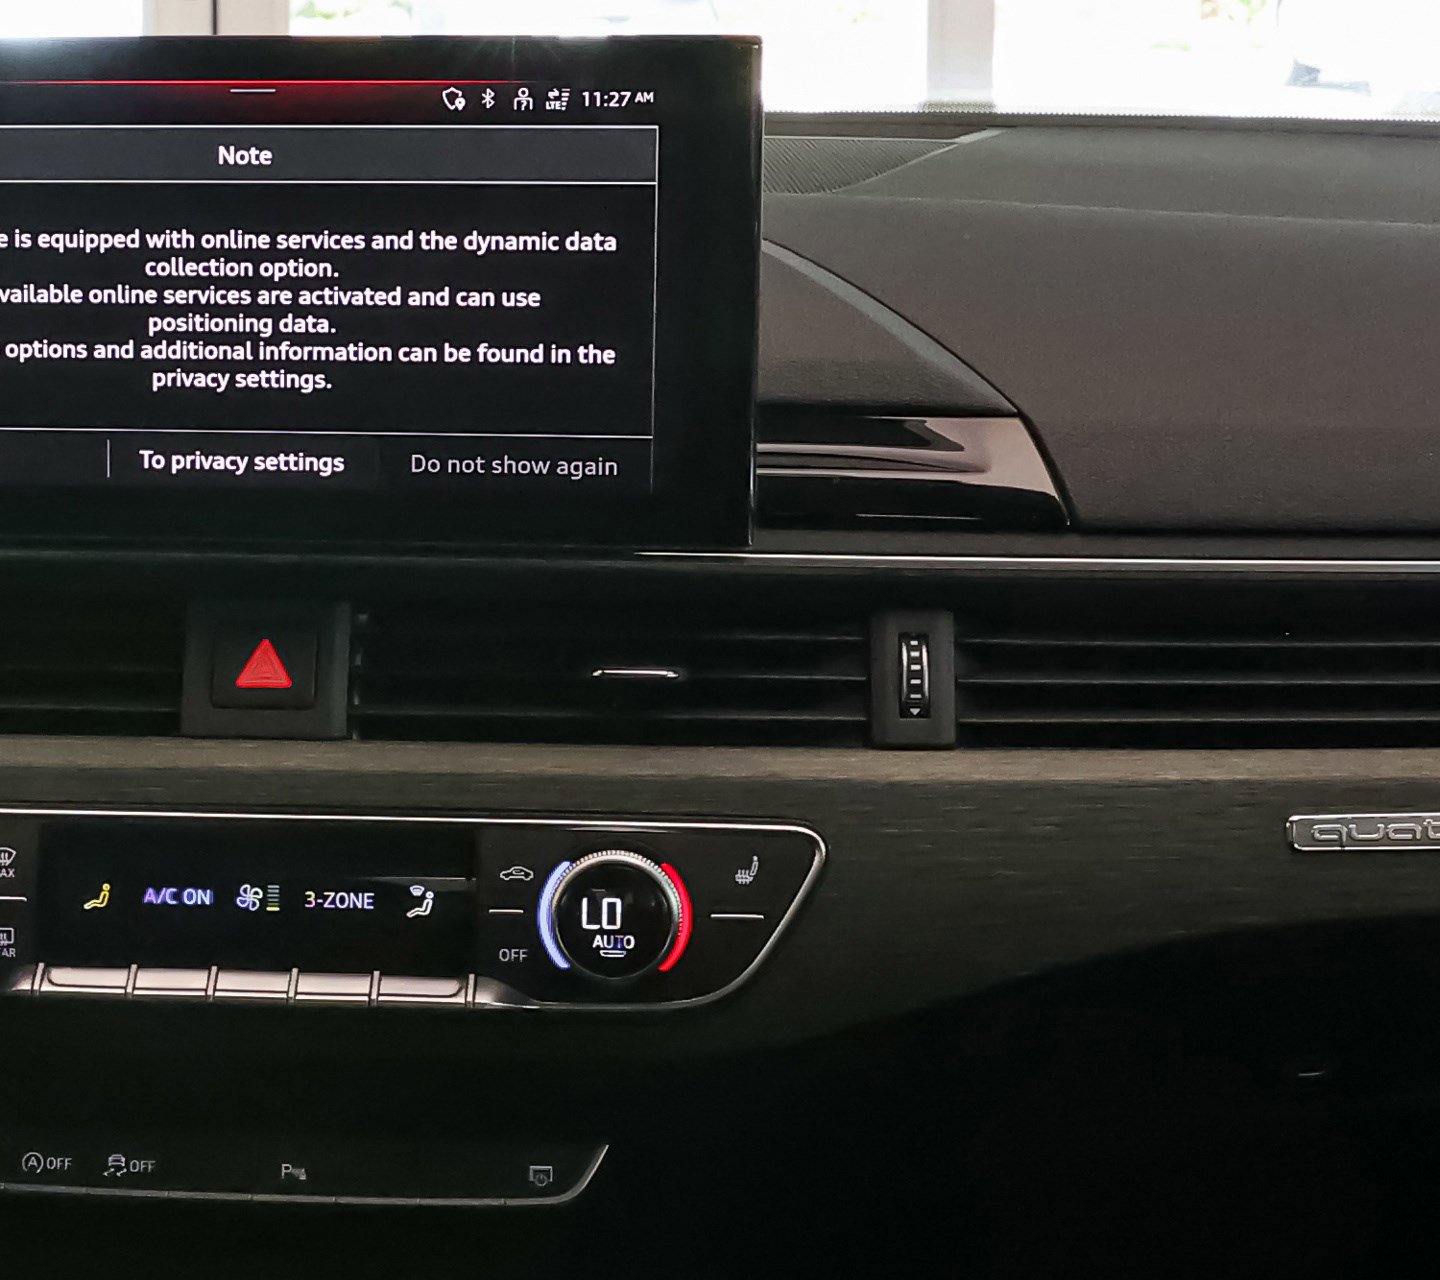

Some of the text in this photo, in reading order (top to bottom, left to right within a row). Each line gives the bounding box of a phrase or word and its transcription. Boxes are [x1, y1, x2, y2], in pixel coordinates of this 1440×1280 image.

[583, 92, 654, 107] 11:27 AM
[219, 146, 272, 165] Note
[15, 229, 32, 248] is
[38, 229, 139, 253] equipped
[146, 229, 194, 248] with
[201, 229, 270, 249] online
[277, 230, 365, 249] services
[372, 230, 413, 250] and
[419, 230, 457, 250] the
[464, 230, 559, 255] dynamic
[565, 231, 616, 251] data
[145, 257, 338, 281] collection option.
[89, 284, 157, 304] online
[164, 286, 251, 304] services
[257, 290, 292, 304] are
[299, 286, 401, 305] activated
[408, 287, 449, 306] and
[456, 292, 495, 306] can
[502, 292, 540, 307] use
[149, 313, 336, 337] positioning data.
[5, 339, 87, 363] options
[94, 340, 134, 358] and
[141, 340, 253, 360] additional
[259, 341, 392, 361] information
[398, 347, 437, 362] can
[444, 343, 471, 362] be
[477, 343, 543, 363] found
[551, 344, 571, 363] in
[577, 344, 615, 364] the
[153, 368, 332, 393] privacy settings.
[139, 450, 344, 476] To privacy settings
[412, 455, 617, 479] Do not show again
[144, 888, 213, 906] A/C ON
[304, 891, 375, 910] 3-ZONE
[592, 935, 635, 950] AUTO
[498, 948, 528, 962] OFF
[46, 1157, 72, 1170] OFF
[129, 1160, 156, 1172] OFF
